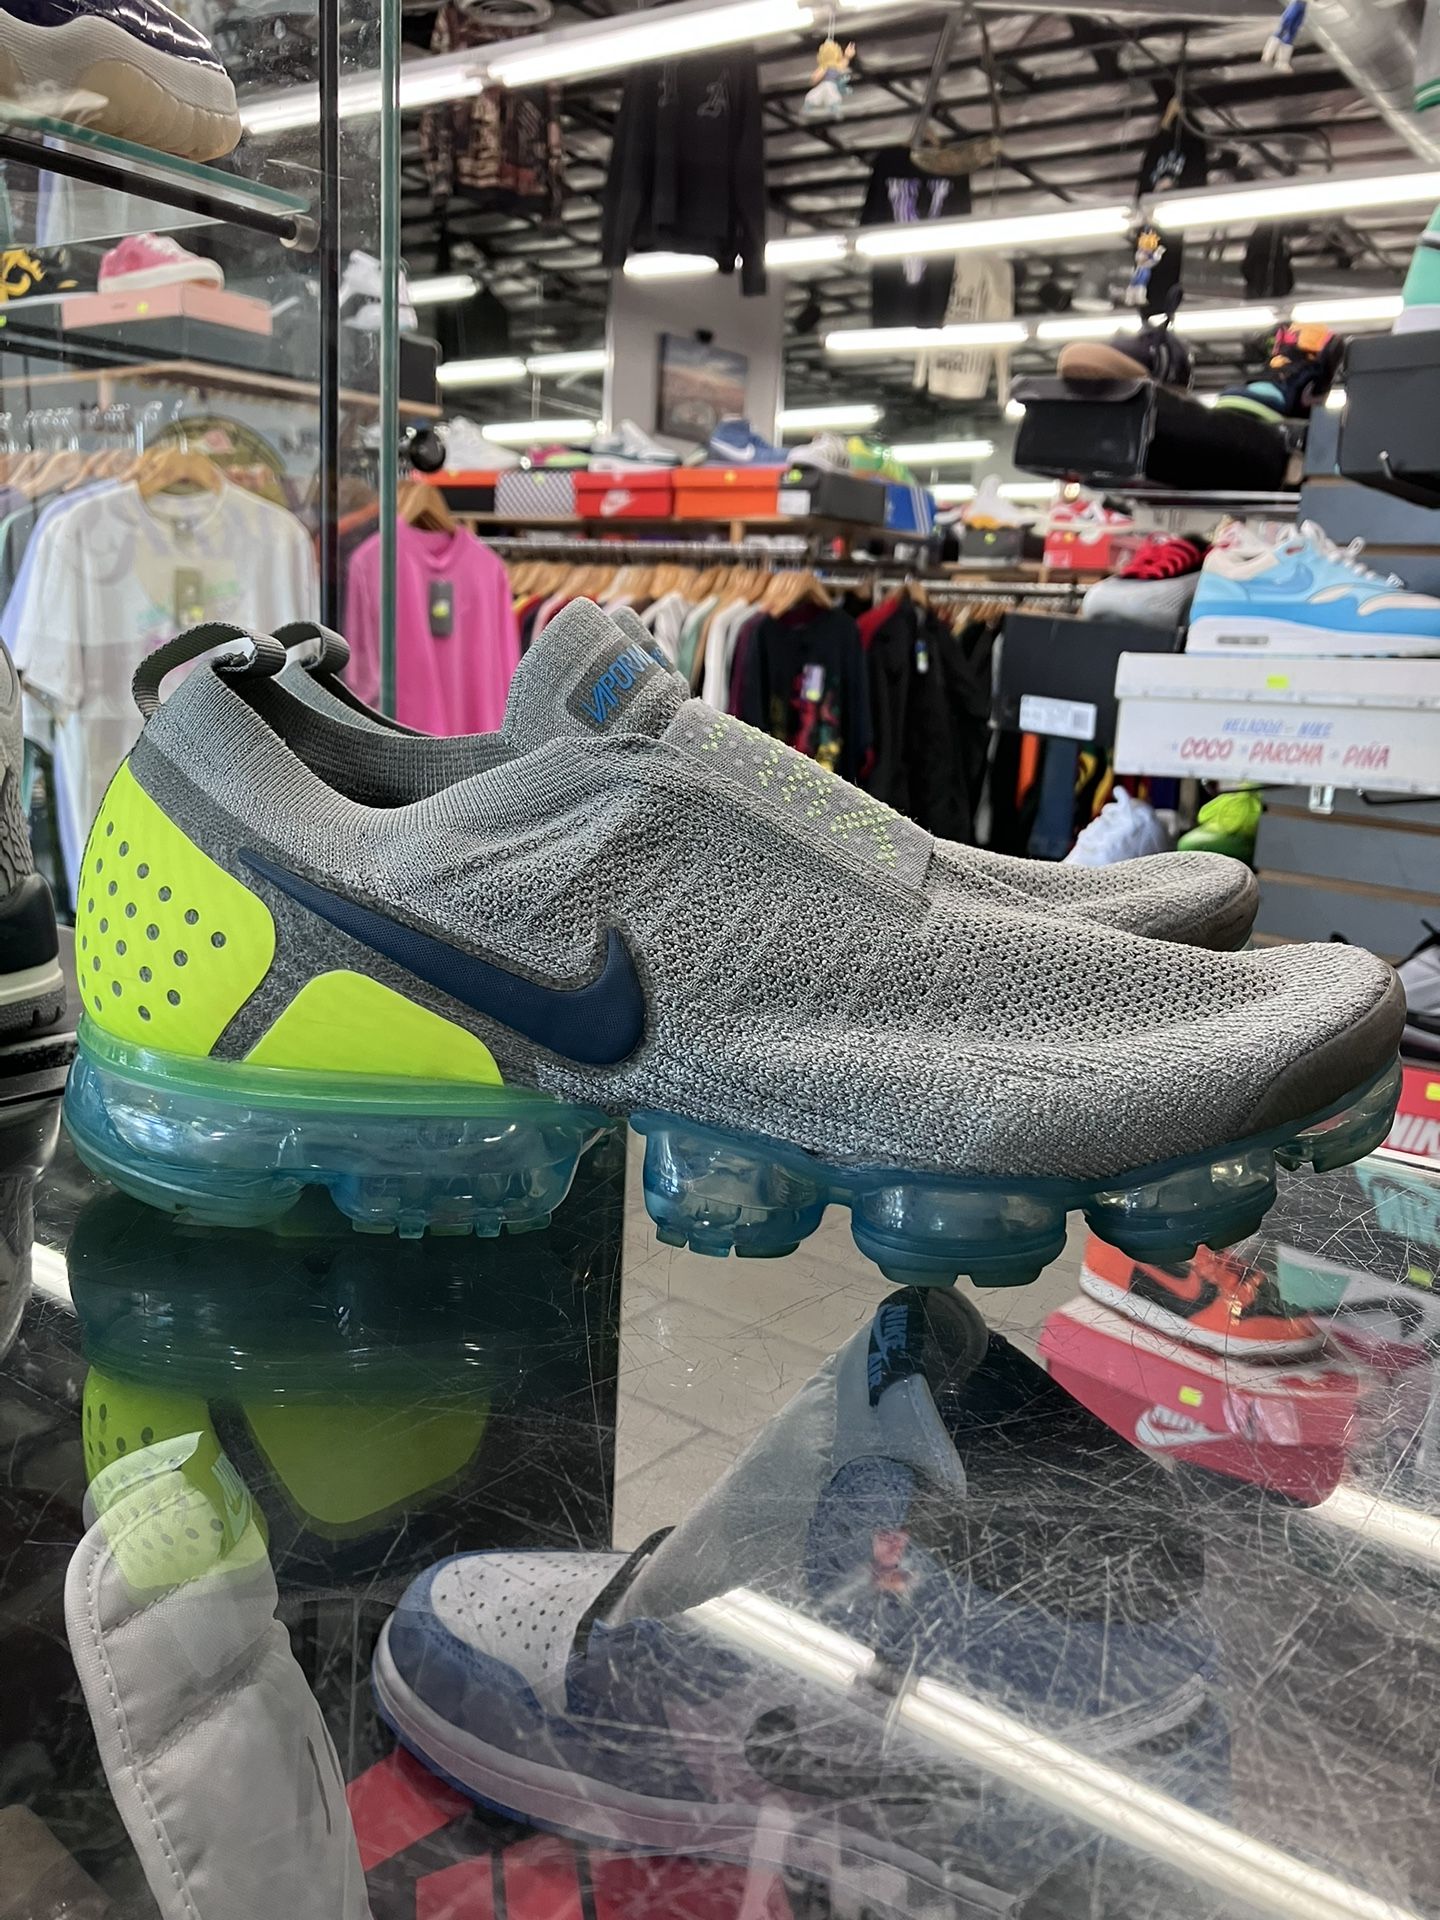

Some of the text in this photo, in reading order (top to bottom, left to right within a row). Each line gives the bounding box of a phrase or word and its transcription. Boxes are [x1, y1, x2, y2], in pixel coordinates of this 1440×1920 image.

[1180, 736, 1392, 770] COCO PARCHA PIÑA
[882, 1303, 909, 1349] NIKE
